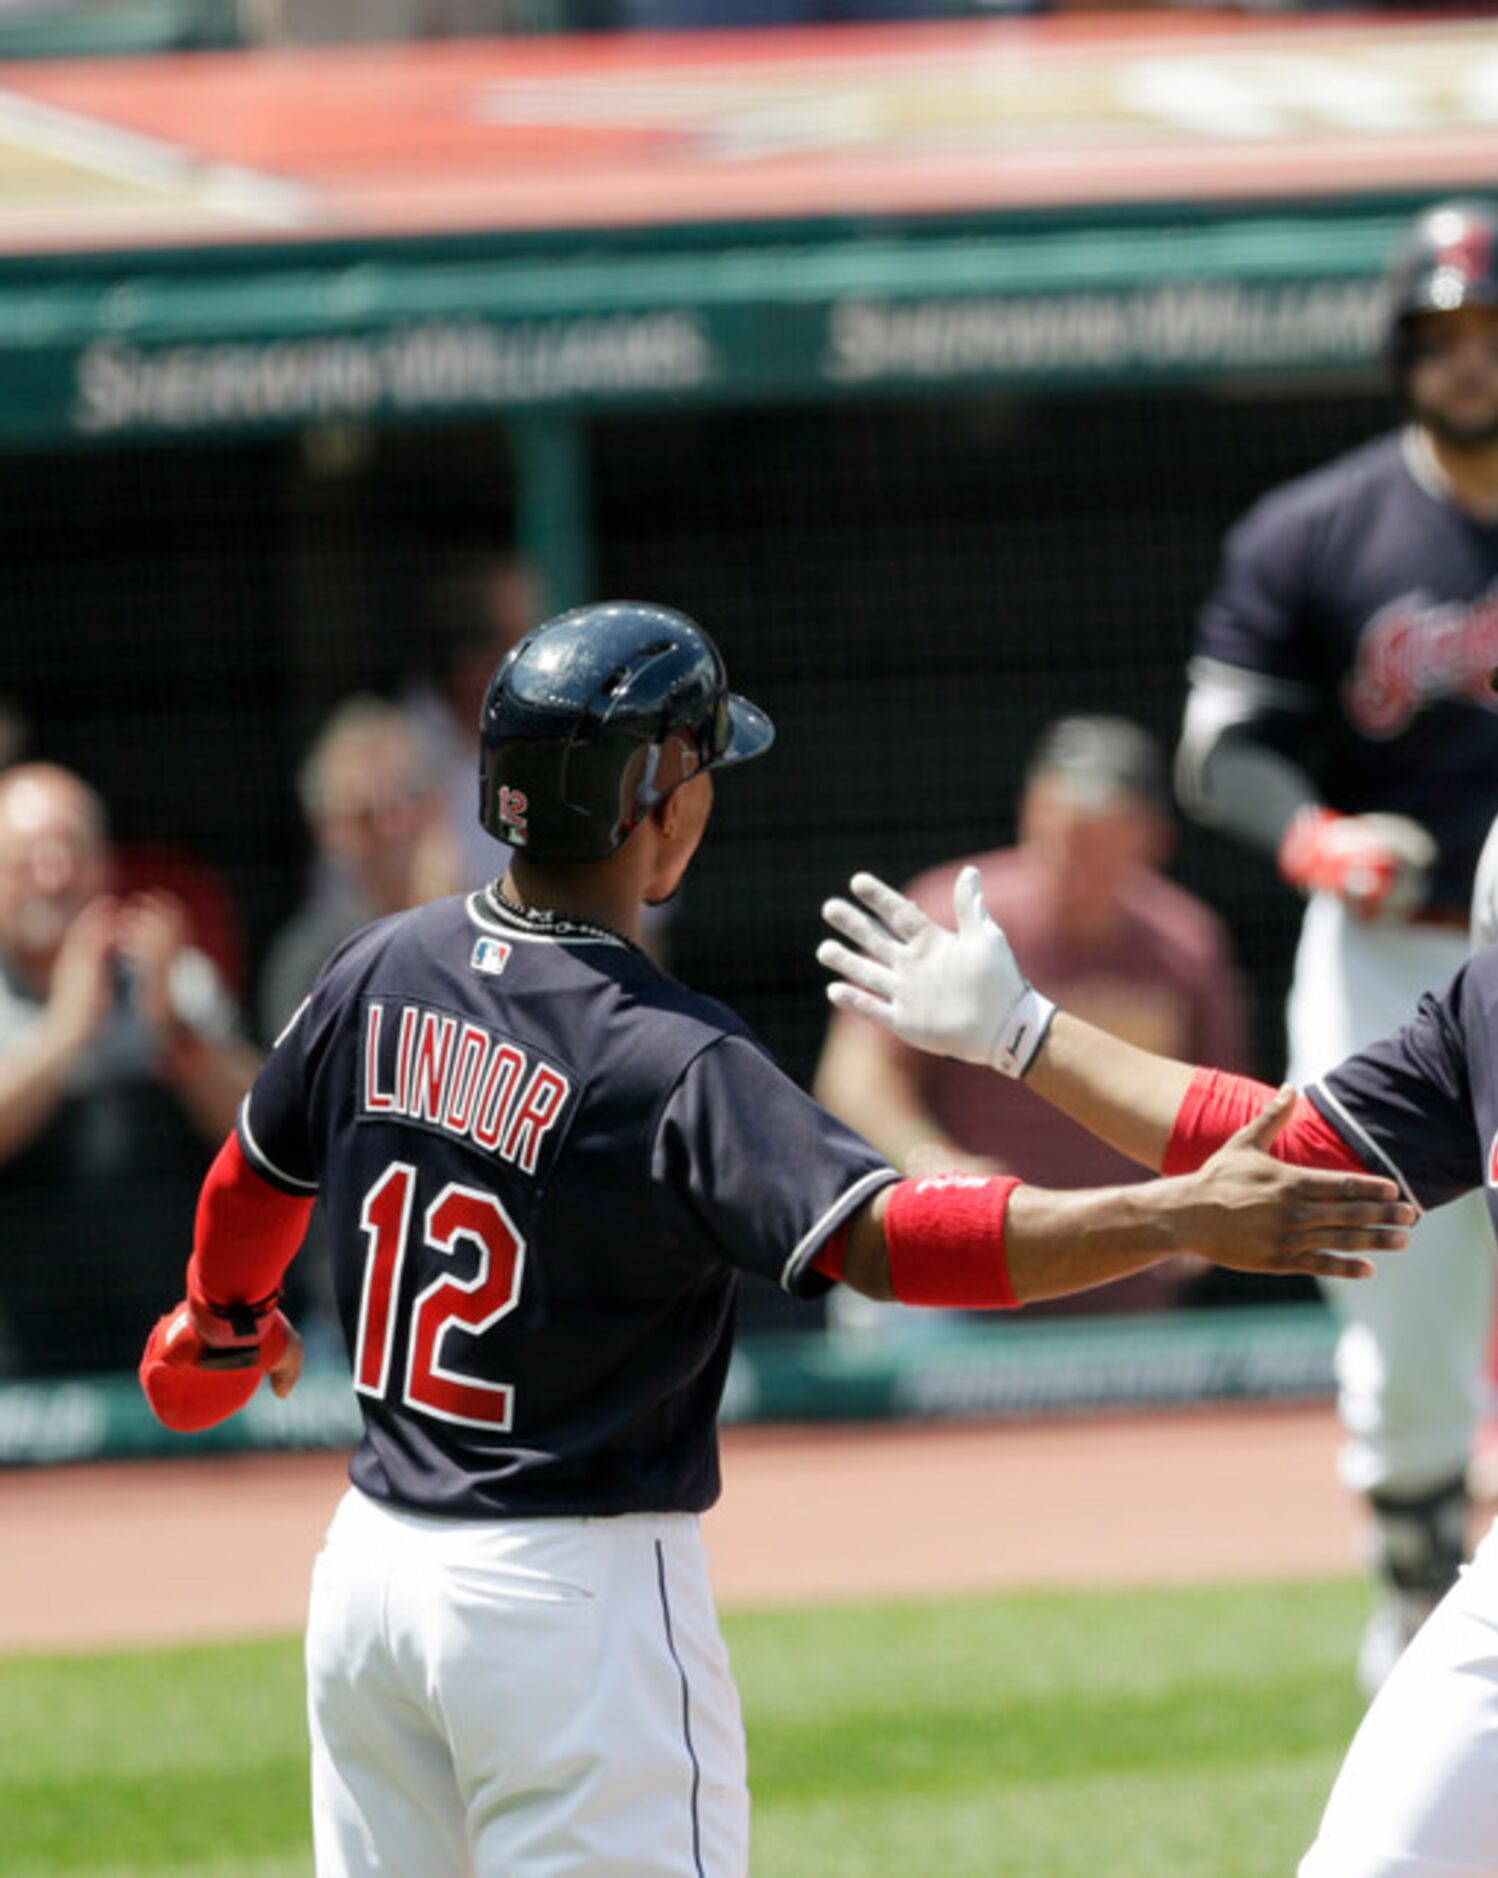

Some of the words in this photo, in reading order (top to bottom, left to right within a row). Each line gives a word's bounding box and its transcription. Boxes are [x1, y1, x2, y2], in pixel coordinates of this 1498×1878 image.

[498, 785, 528, 828] 12
[364, 1003, 570, 1176] LINDOR
[353, 1160, 527, 1432] 12
